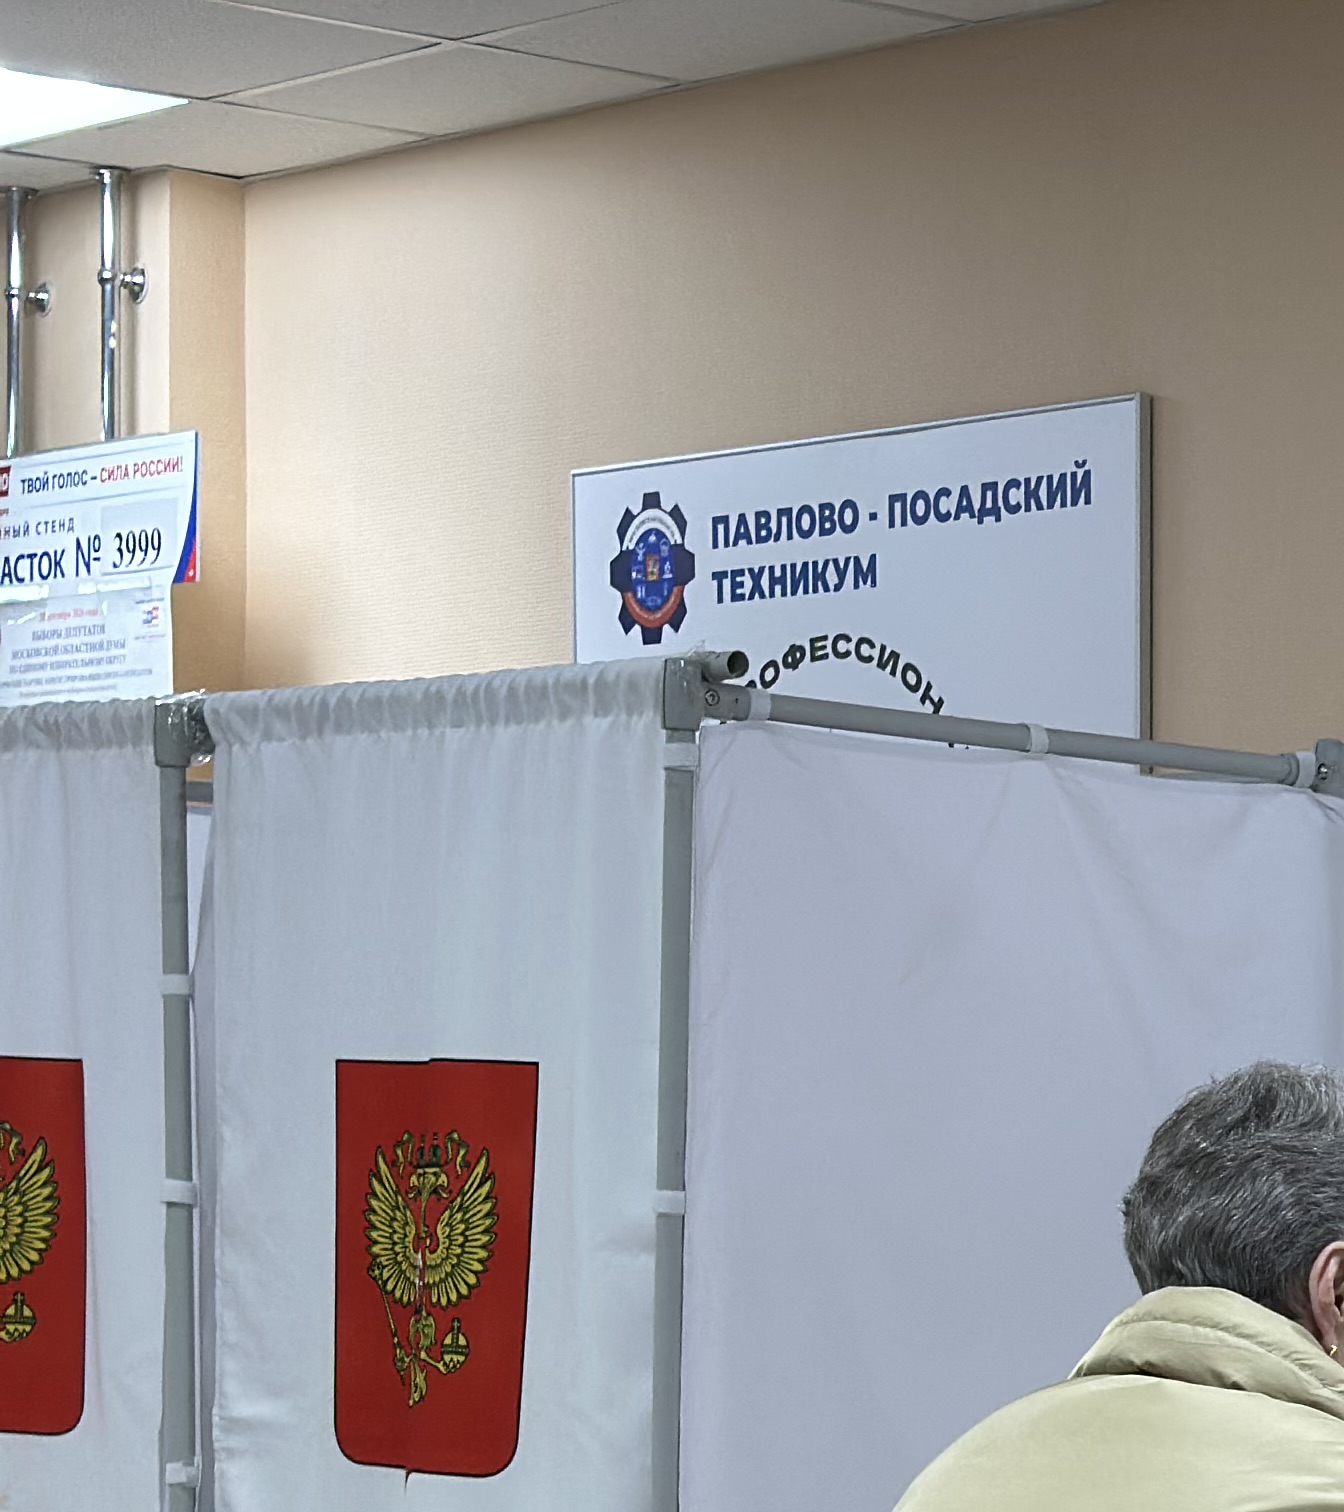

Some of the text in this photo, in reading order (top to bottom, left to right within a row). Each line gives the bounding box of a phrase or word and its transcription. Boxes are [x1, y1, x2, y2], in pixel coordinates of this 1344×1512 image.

[21, 471, 49, 495] ТВОЙ
[51, 470, 88, 490] ГОЛОС
[100, 464, 130, 484] СИЛА
[133, 456, 184, 478] РОССИИ!
[35, 517, 75, 536] СТЕНД
[711, 498, 860, 549] ПАВЛОВО
[887, 460, 1092, 530] ПОСАДСКИЙ
[0, 527, 162, 586] АСТОК № 3999
[711, 553, 878, 605] ТЕХНИКУМ
[745, 632, 945, 715] ОФЕССИОН
